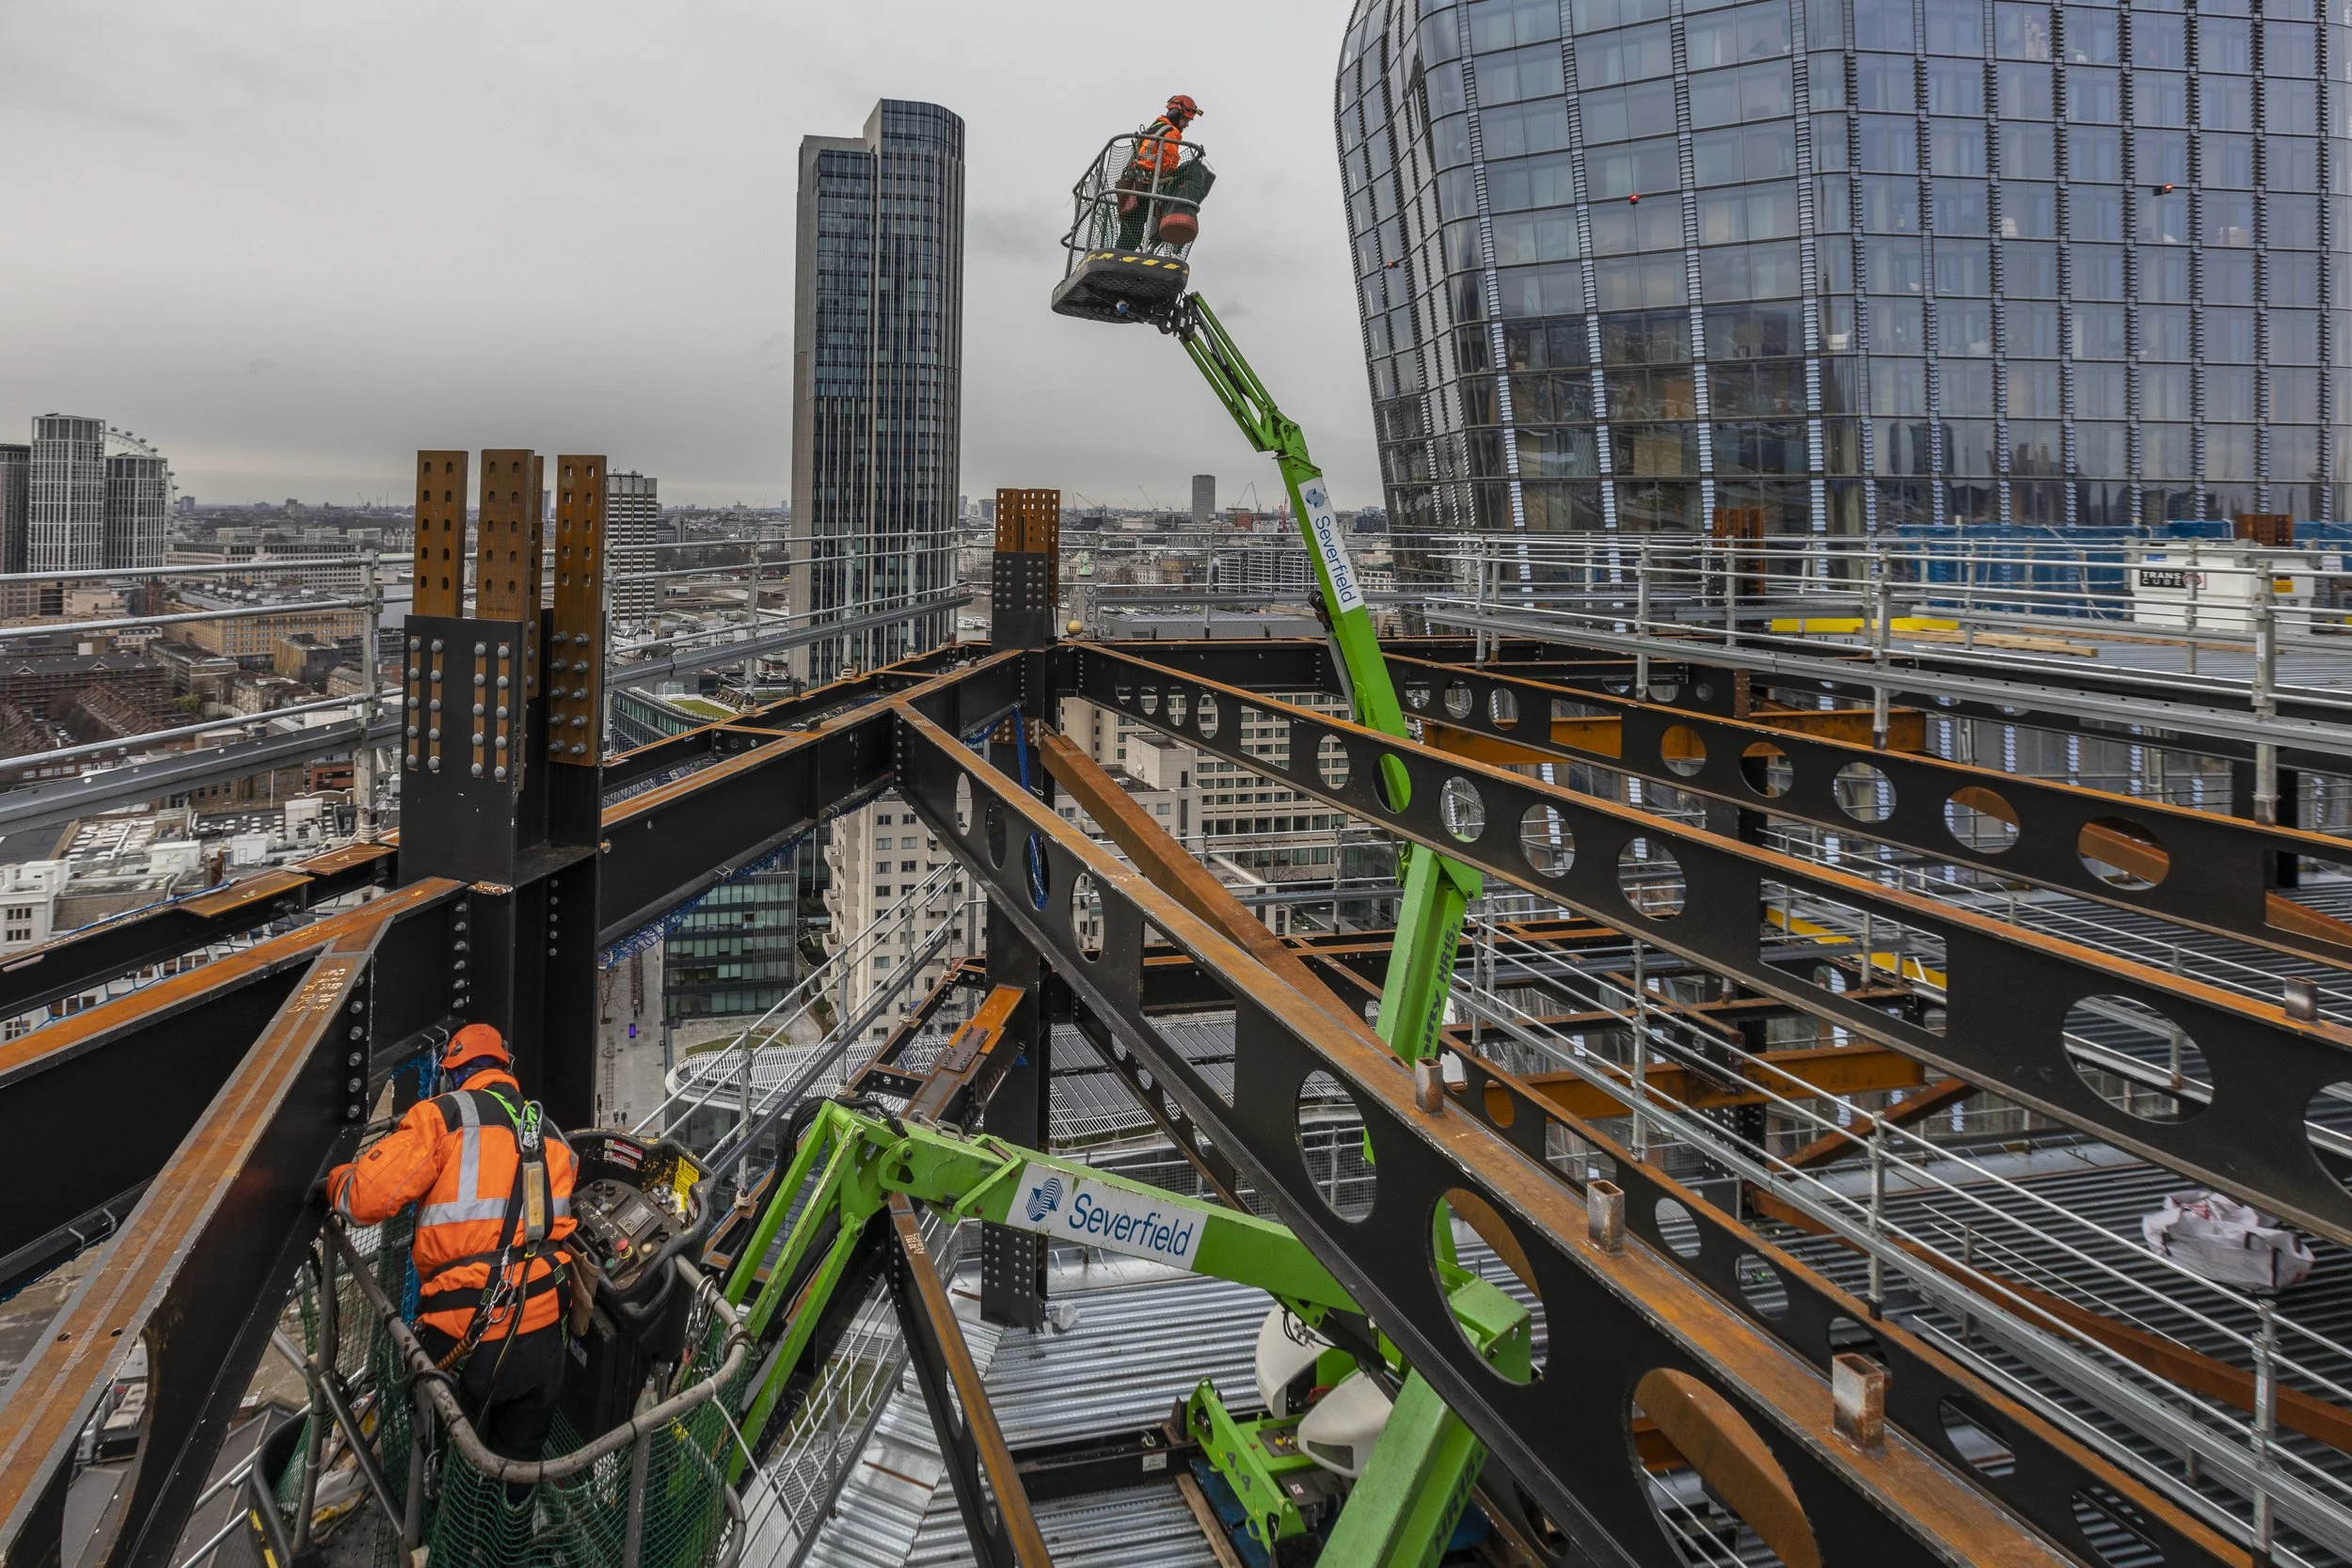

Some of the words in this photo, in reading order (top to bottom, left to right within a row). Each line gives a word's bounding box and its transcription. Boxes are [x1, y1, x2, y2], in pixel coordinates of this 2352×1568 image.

[1315, 515, 1357, 603] Severfield
[2141, 571, 2182, 579] TRANS
[2141, 578, 2182, 586] CUBE
[1069, 1193, 1194, 1257] Severfield
